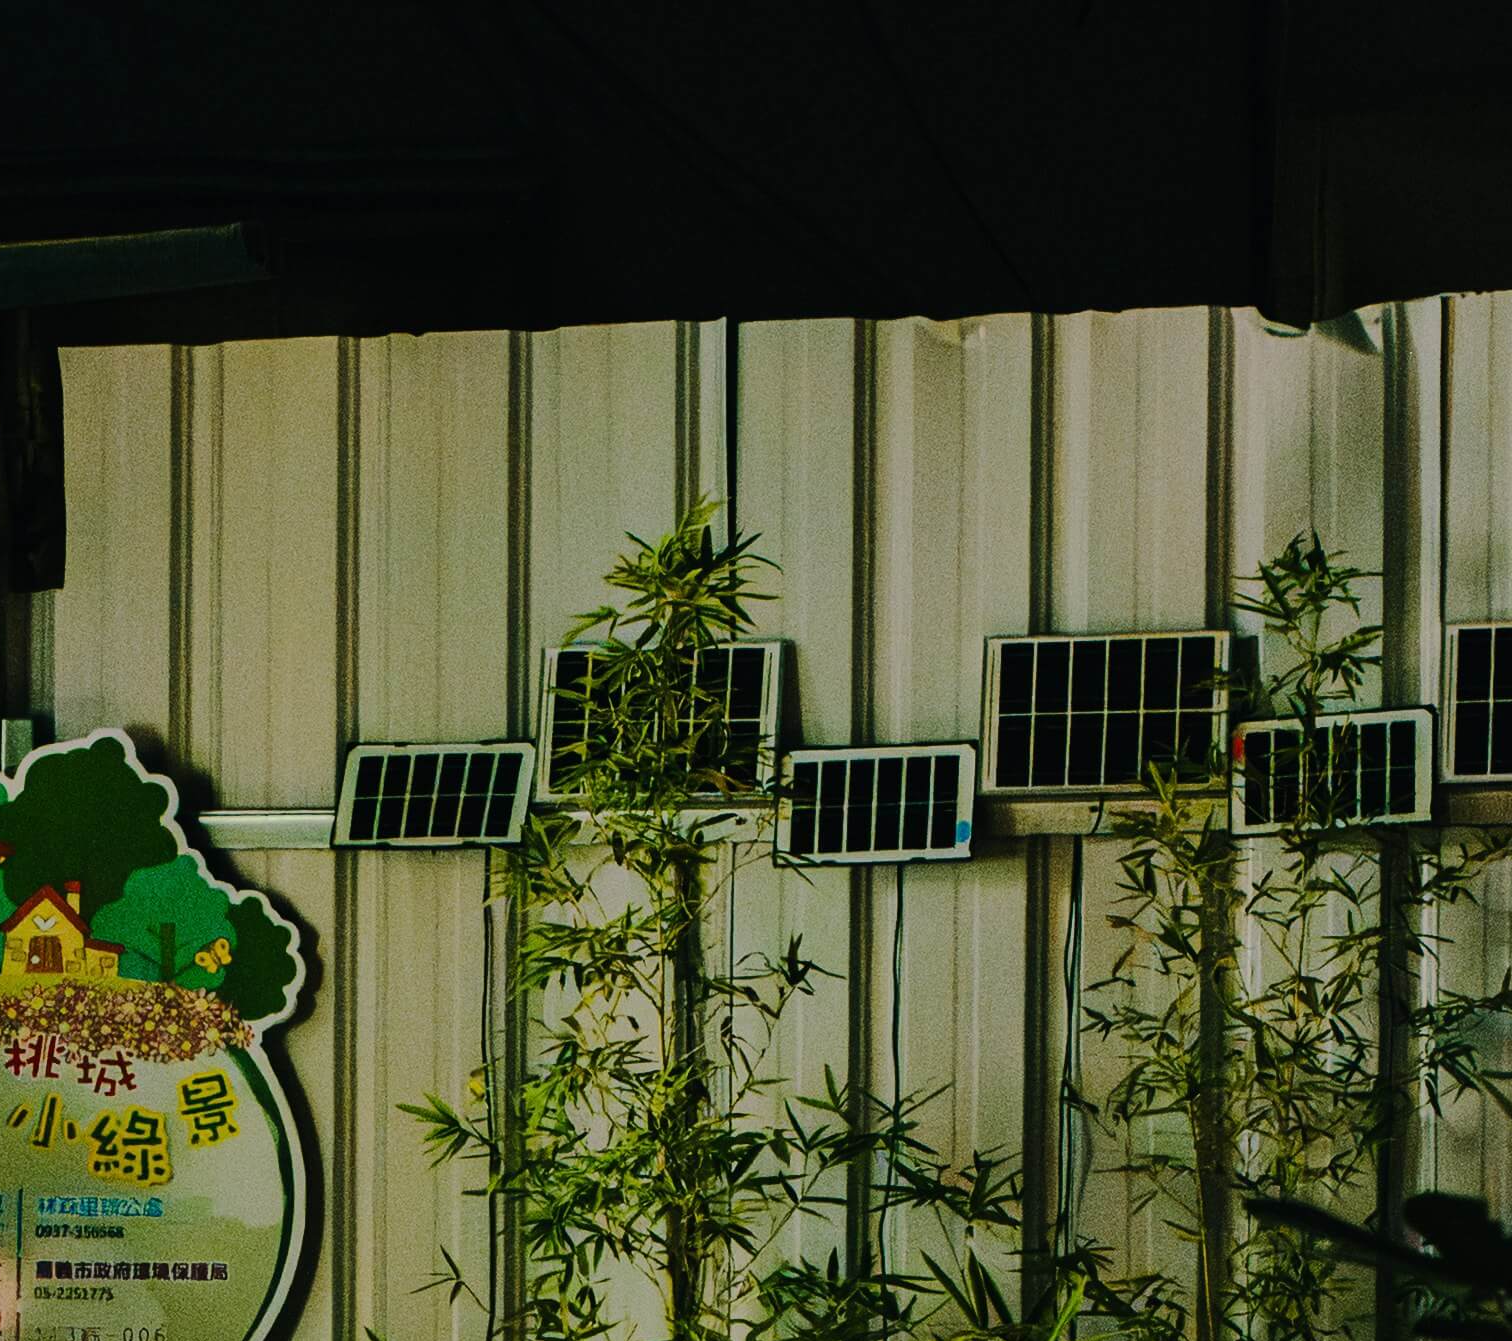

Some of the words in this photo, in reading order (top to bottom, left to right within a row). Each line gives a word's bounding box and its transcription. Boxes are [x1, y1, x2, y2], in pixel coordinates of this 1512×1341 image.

[5, 1034, 136, 1096] 桃城
[7, 1069, 239, 1186] 小綠景
